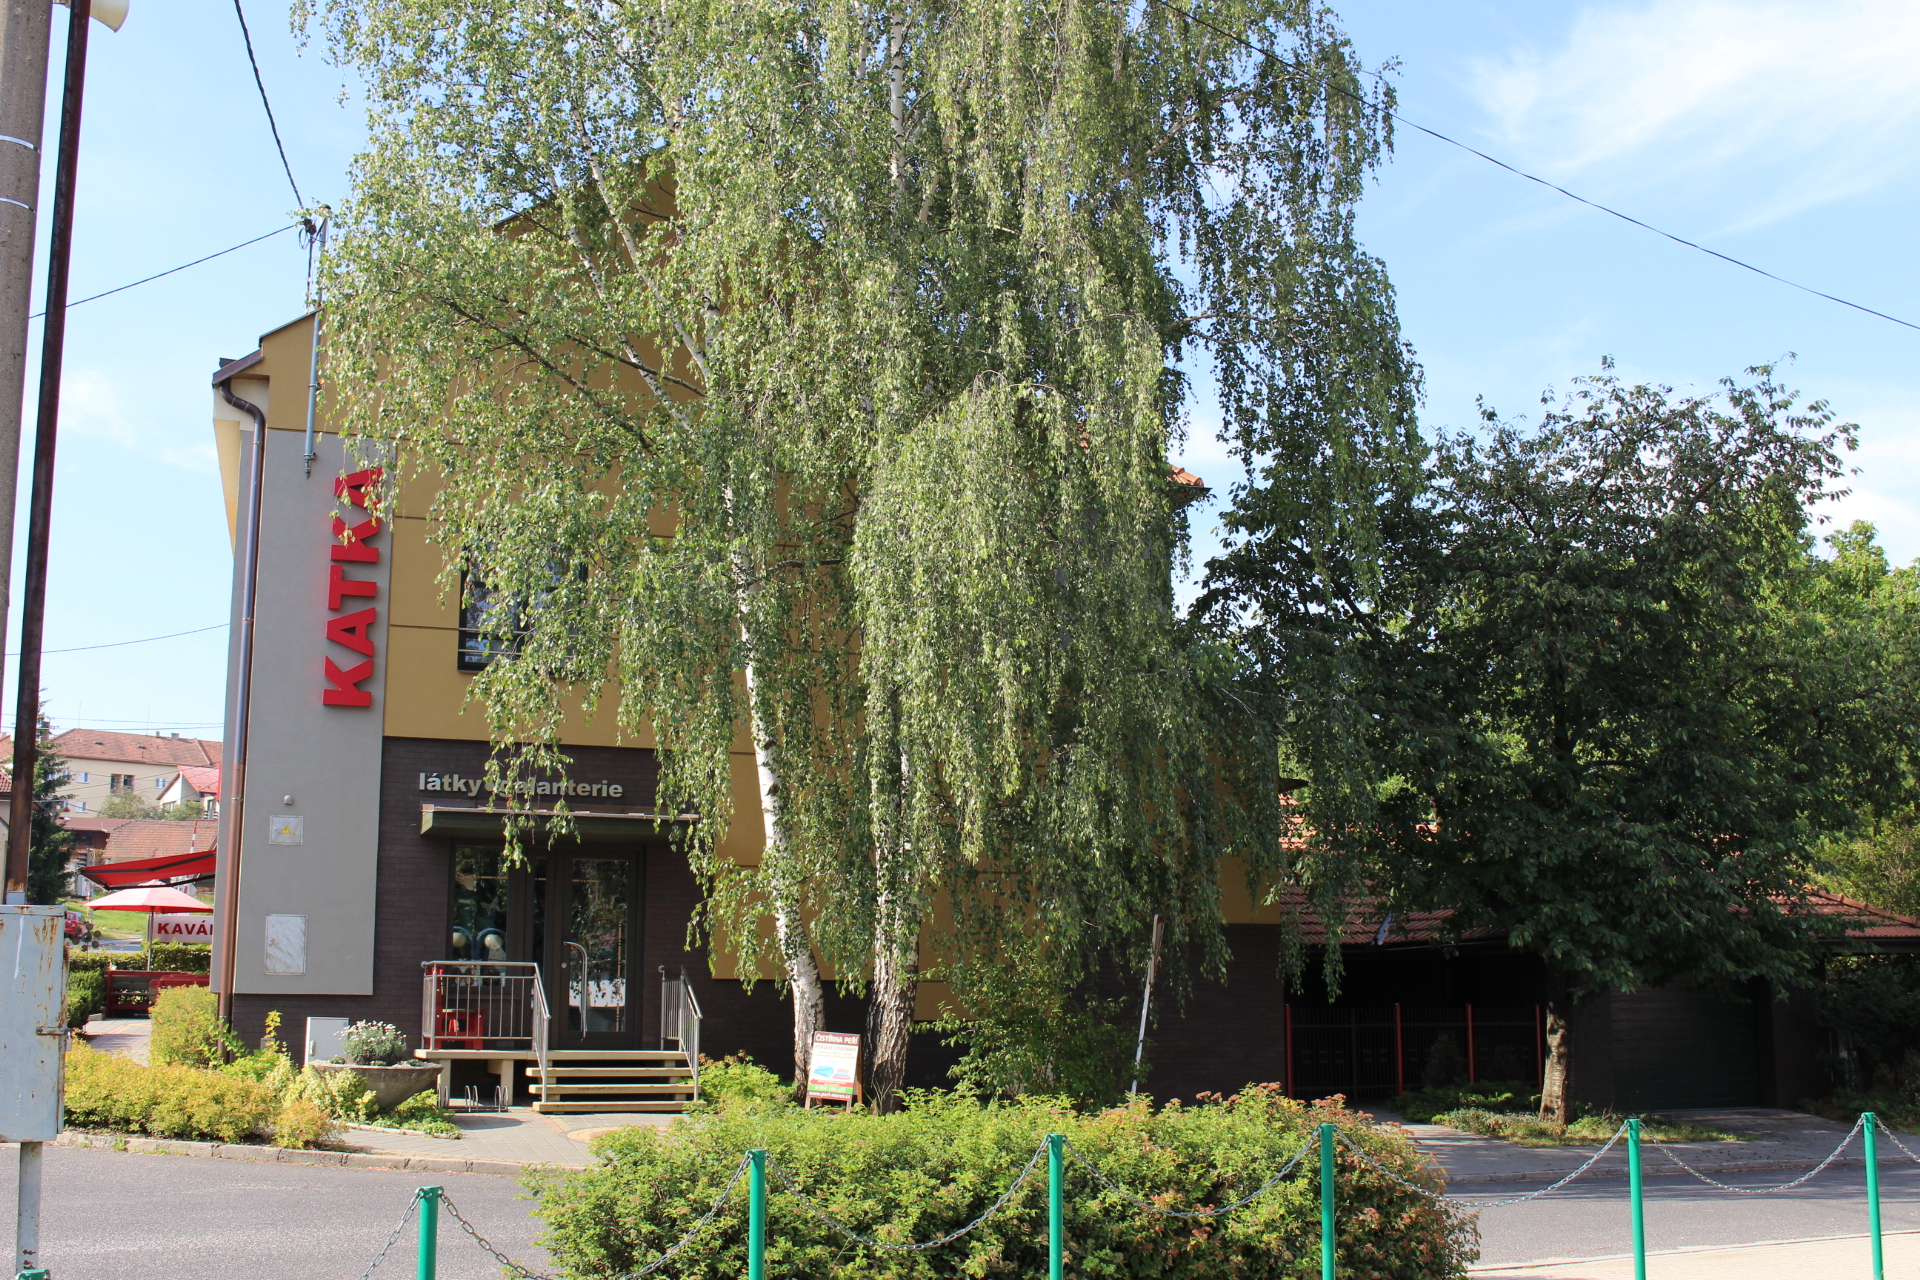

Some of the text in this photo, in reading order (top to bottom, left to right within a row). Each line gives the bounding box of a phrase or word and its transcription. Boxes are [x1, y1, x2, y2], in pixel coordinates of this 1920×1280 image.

[322, 466, 384, 707] KATKA
[419, 773, 623, 798] látky galanterie
